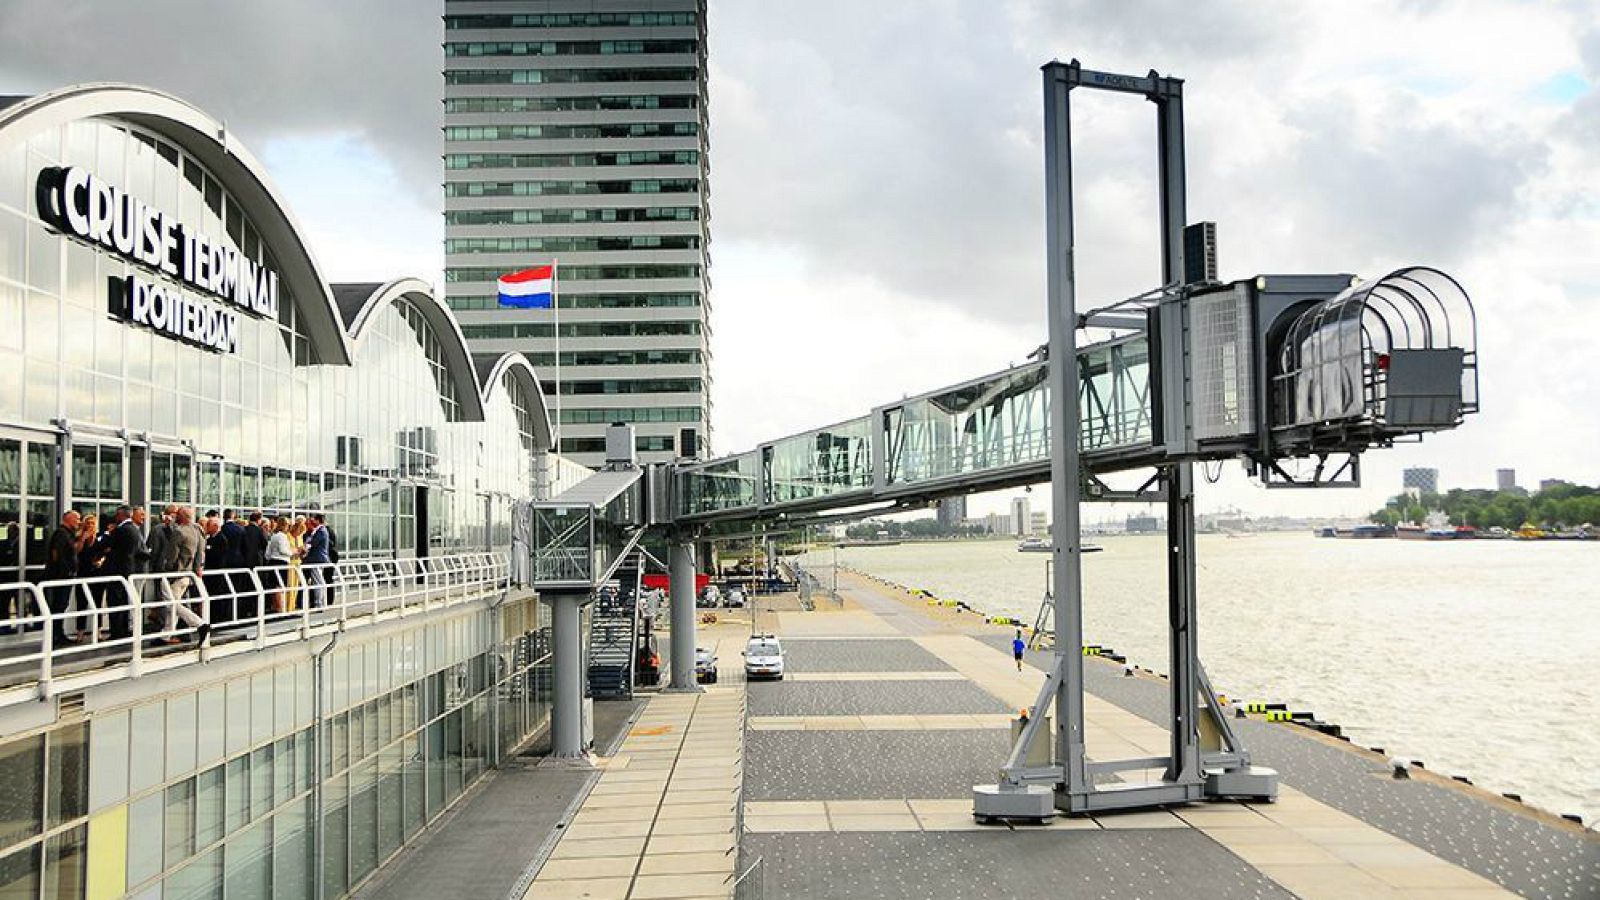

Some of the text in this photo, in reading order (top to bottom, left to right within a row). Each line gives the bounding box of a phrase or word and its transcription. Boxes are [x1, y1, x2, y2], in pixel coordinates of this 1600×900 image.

[64, 166, 279, 319] CRUISE TERMINAL
[133, 275, 237, 352] ROTTERDAM
